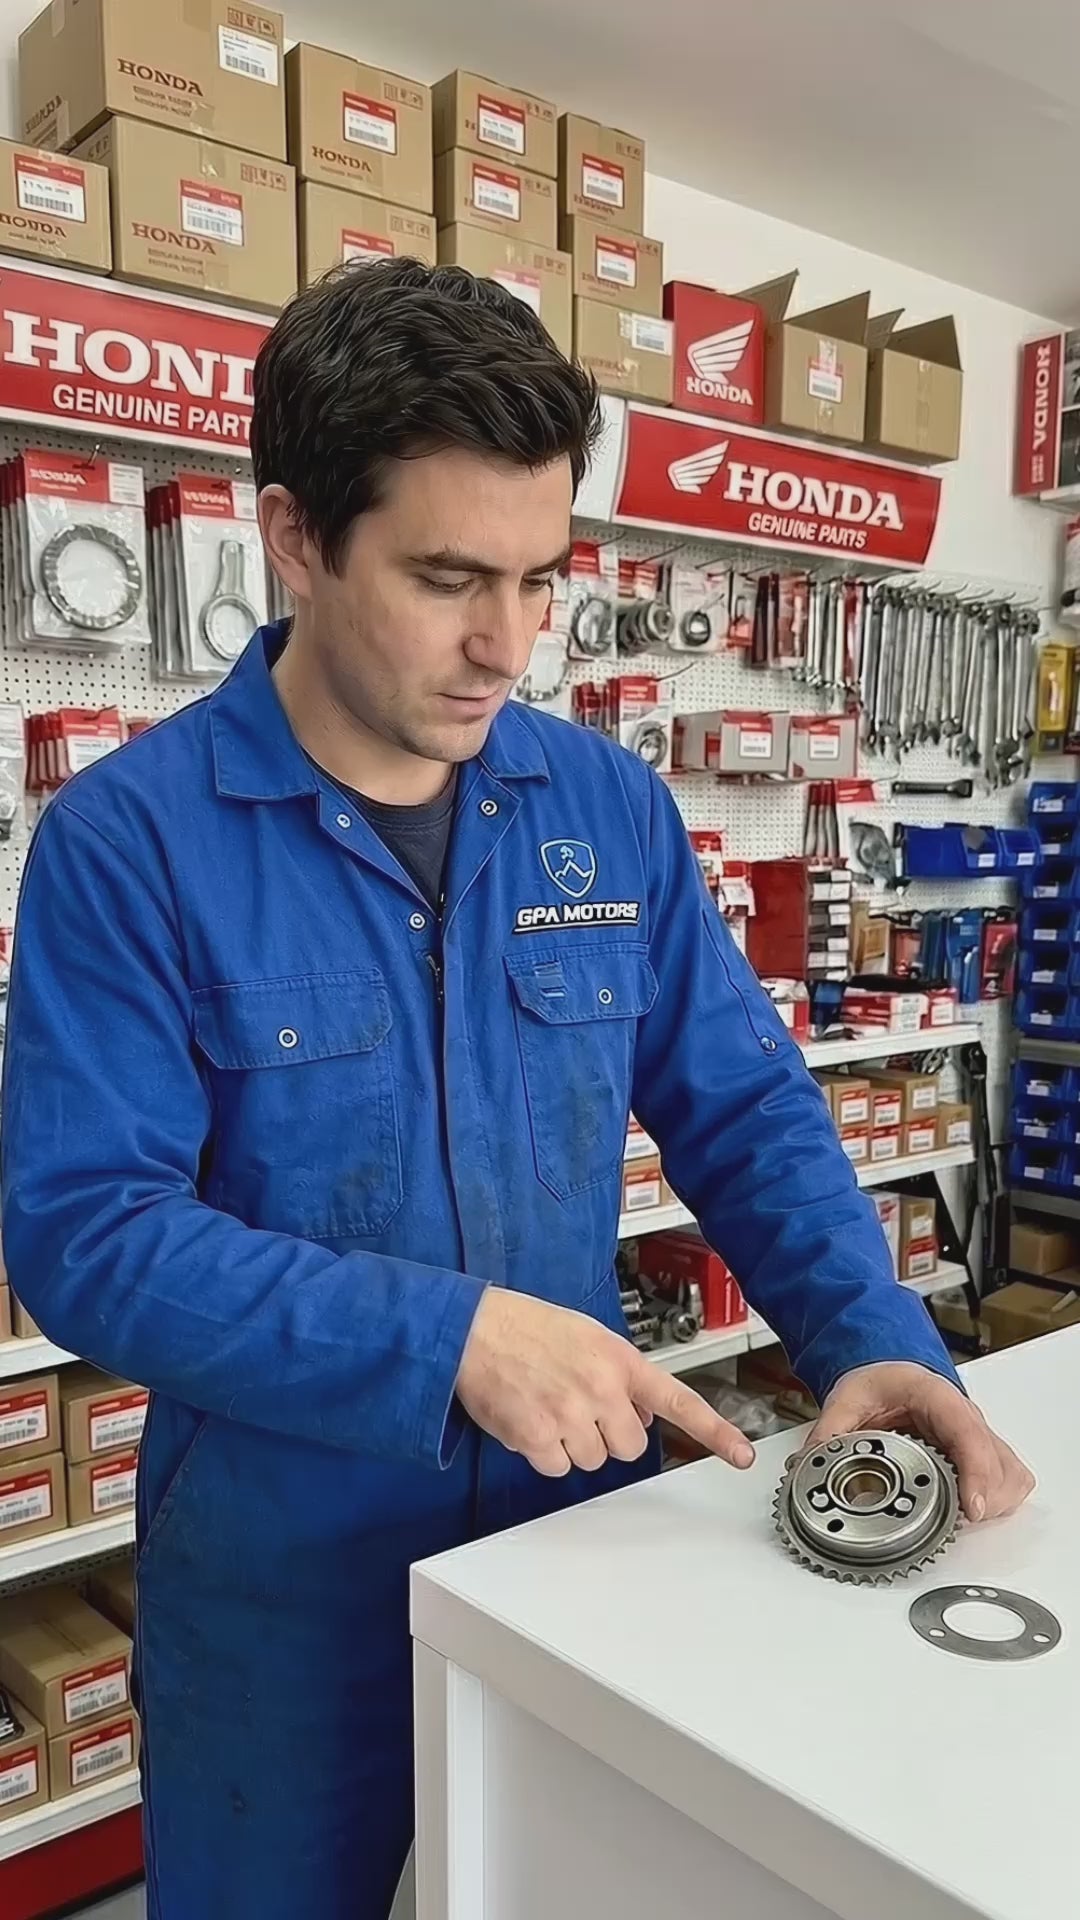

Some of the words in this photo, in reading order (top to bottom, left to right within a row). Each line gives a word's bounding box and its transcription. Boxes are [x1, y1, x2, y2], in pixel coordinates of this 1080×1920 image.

[117, 58, 204, 97] HONDA
[312, 145, 373, 173] HONDA
[131, 222, 217, 256] HONDA
[3, 309, 256, 406] HOND
[686, 376, 754, 406] HONDA
[1032, 343, 1051, 451] HONDA
[53, 384, 181, 428] GENUINE
[187, 407, 252, 440] PART
[723, 461, 904, 531] HONDA
[517, 906, 560, 926] GPA
[563, 902, 639, 922] MOTORS
